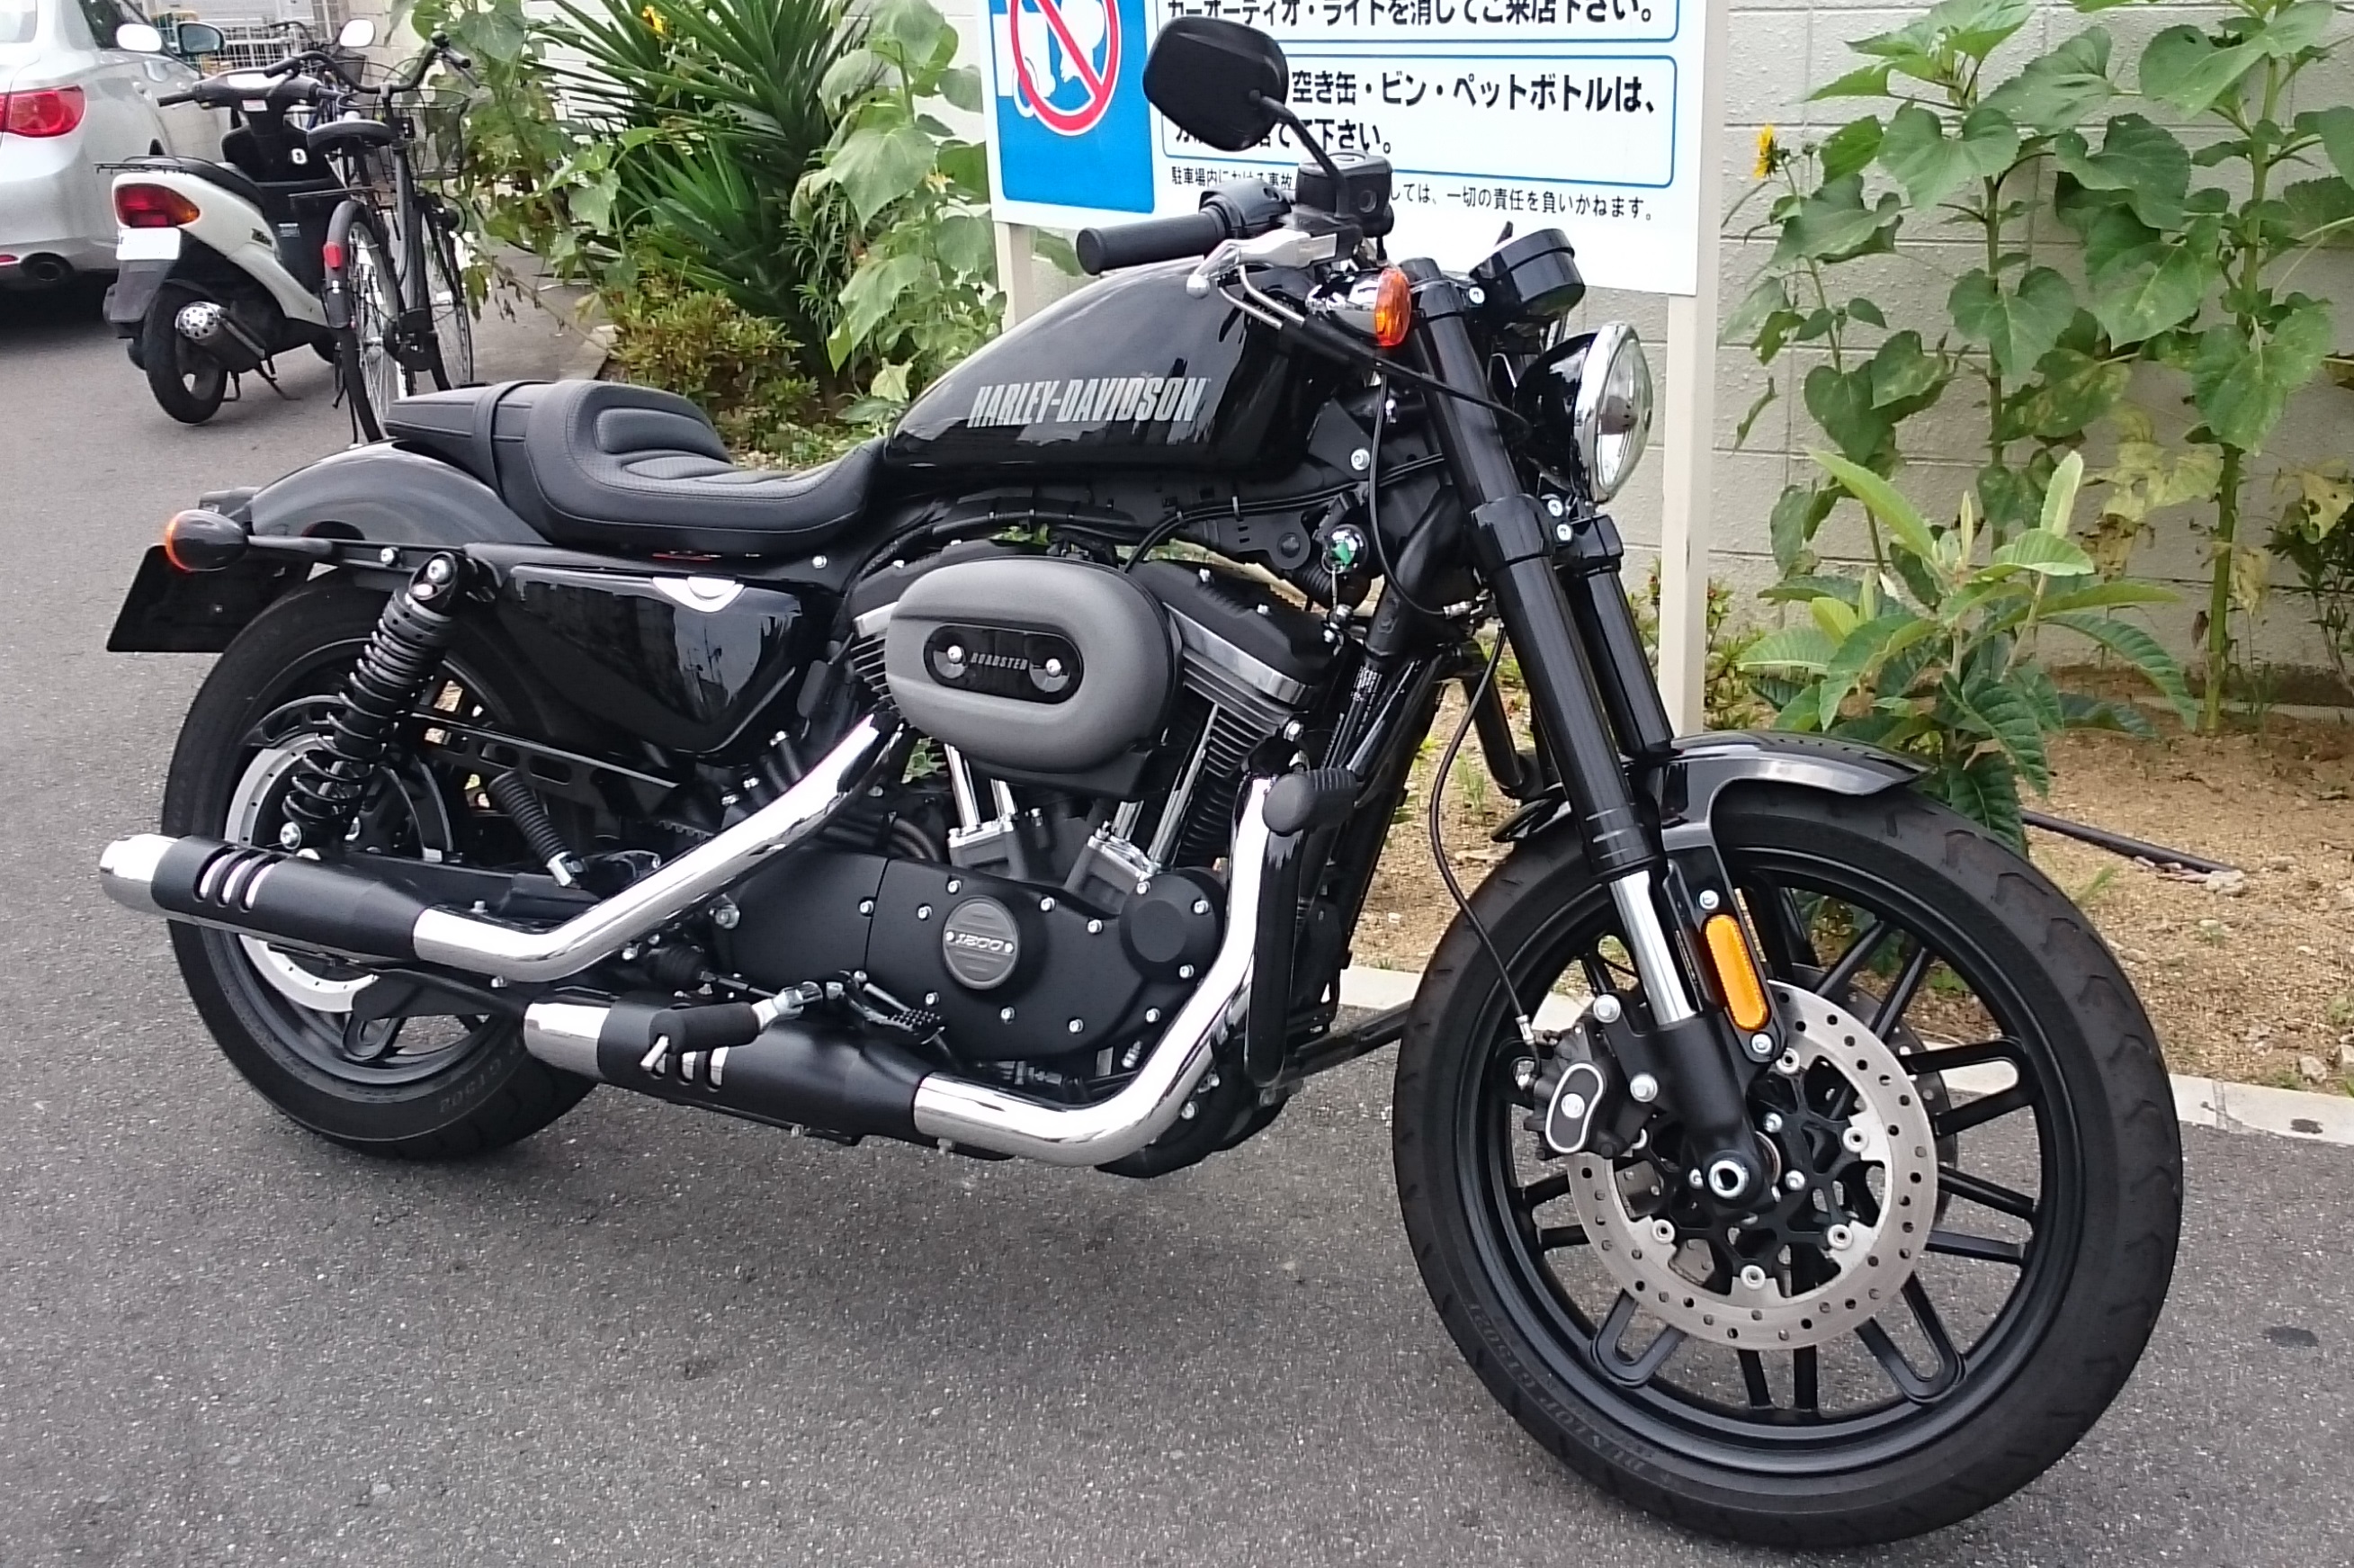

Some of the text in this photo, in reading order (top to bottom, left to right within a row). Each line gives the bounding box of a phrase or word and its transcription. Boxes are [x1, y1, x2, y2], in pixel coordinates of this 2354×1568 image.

[968, 377, 1206, 427] HARLEY-DAVIDSON
[971, 652, 1029, 671] ROADSTER
[955, 933, 1005, 951] 1200
